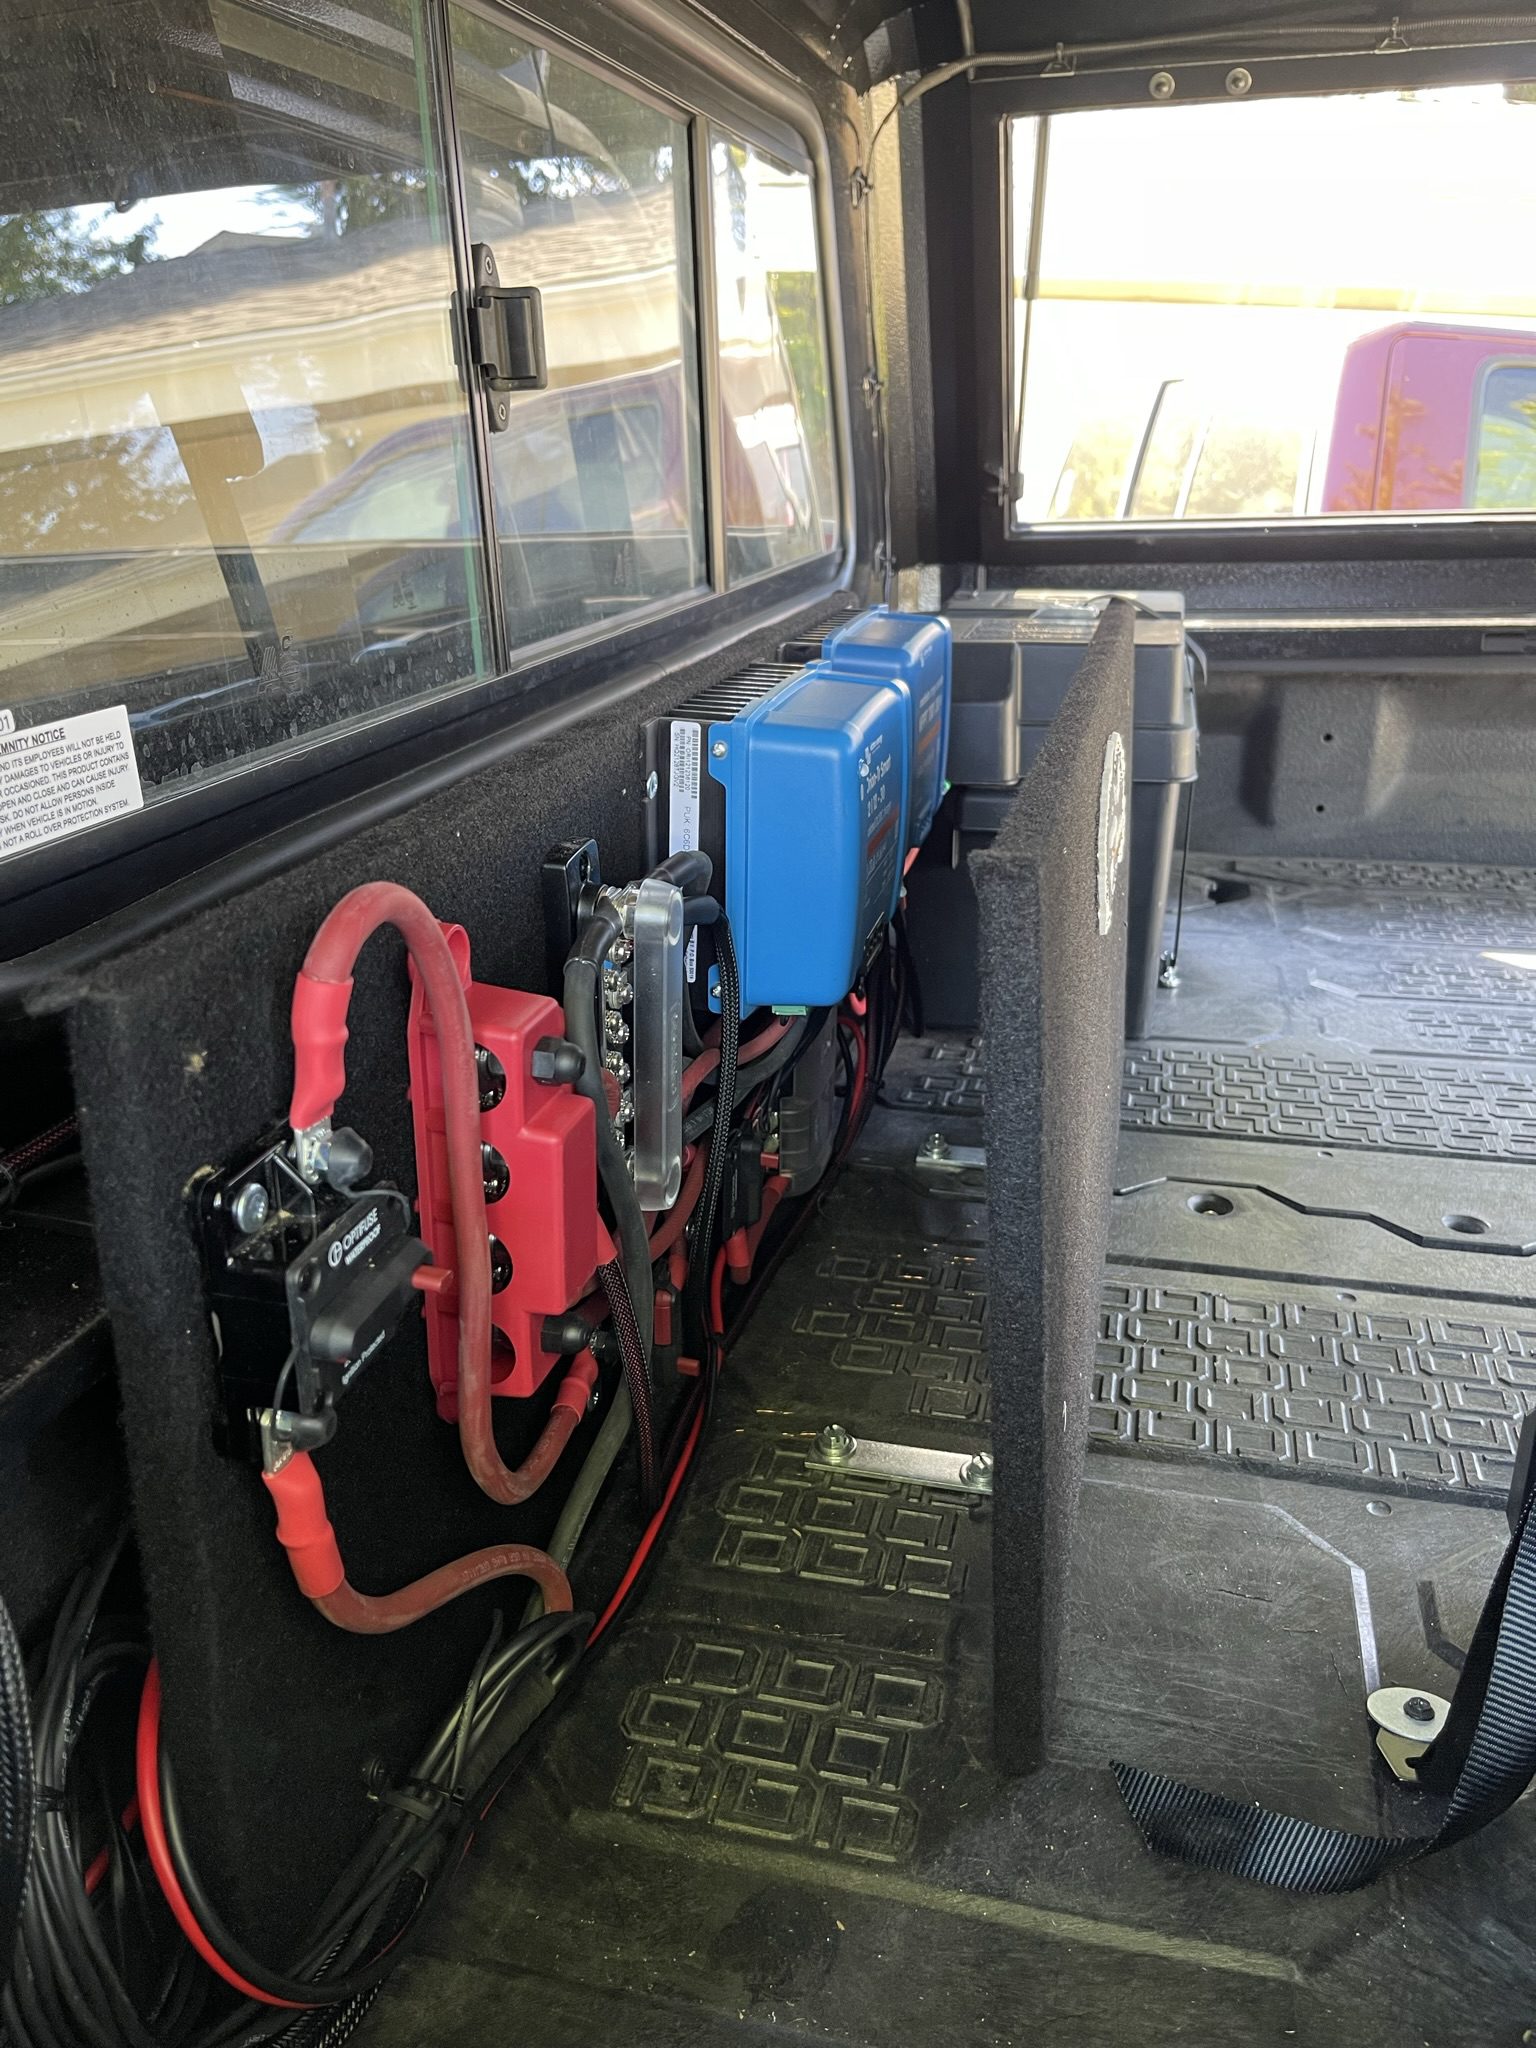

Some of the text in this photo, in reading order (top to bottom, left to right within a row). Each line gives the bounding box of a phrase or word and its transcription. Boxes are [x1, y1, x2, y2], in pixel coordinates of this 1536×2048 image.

[0, 727, 65, 755] MNITY NOTICE
[11, 758, 23, 768] ITS
[24, 746, 64, 764] EMPLOYEES
[65, 742, 81, 752] WILL
[81, 737, 94, 747] NOT
[95, 735, 104, 744] BE
[104, 730, 121, 740] HELD
[4, 766, 38, 783] DAMAGES
[39, 763, 49, 772] TO
[50, 753, 82, 769] VEHICLES
[83, 750, 92, 760] OR
[93, 744, 114, 756] INJURY
[115, 741, 124, 749] TO
[51, 770, 67, 780] THIS
[68, 760, 98, 776] PRODUCT
[99, 751, 129, 767] CONTAINS
[12, 809, 23, 819] DO
[24, 803, 38, 815] NOT
[40, 797, 62, 810] ALLOW
[64, 786, 94, 802] PERSONS
[95, 779, 115, 792] INSIDE
[17, 793, 32, 805] AND
[33, 786, 55, 800] CLOSE
[57, 782, 70, 792] AND
[71, 777, 85, 788] CAN
[85, 770, 106, 783] CAUSE
[107, 764, 128, 776] INJURY
[3, 836, 17, 847] NOT
[19, 834, 24, 843] A
[24, 829, 42, 840] ROLL
[43, 821, 62, 834] OVER
[63, 808, 103, 827] PROTECTION
[4, 822, 26, 834] WHEN
[27, 811, 55, 826] VEHICLE
[56, 808, 63, 817] IS
[683, 807, 691, 824] PUK
[342, 1207, 379, 1251] OPTIFUSE
[344, 1223, 381, 1266] WATERPROOF
